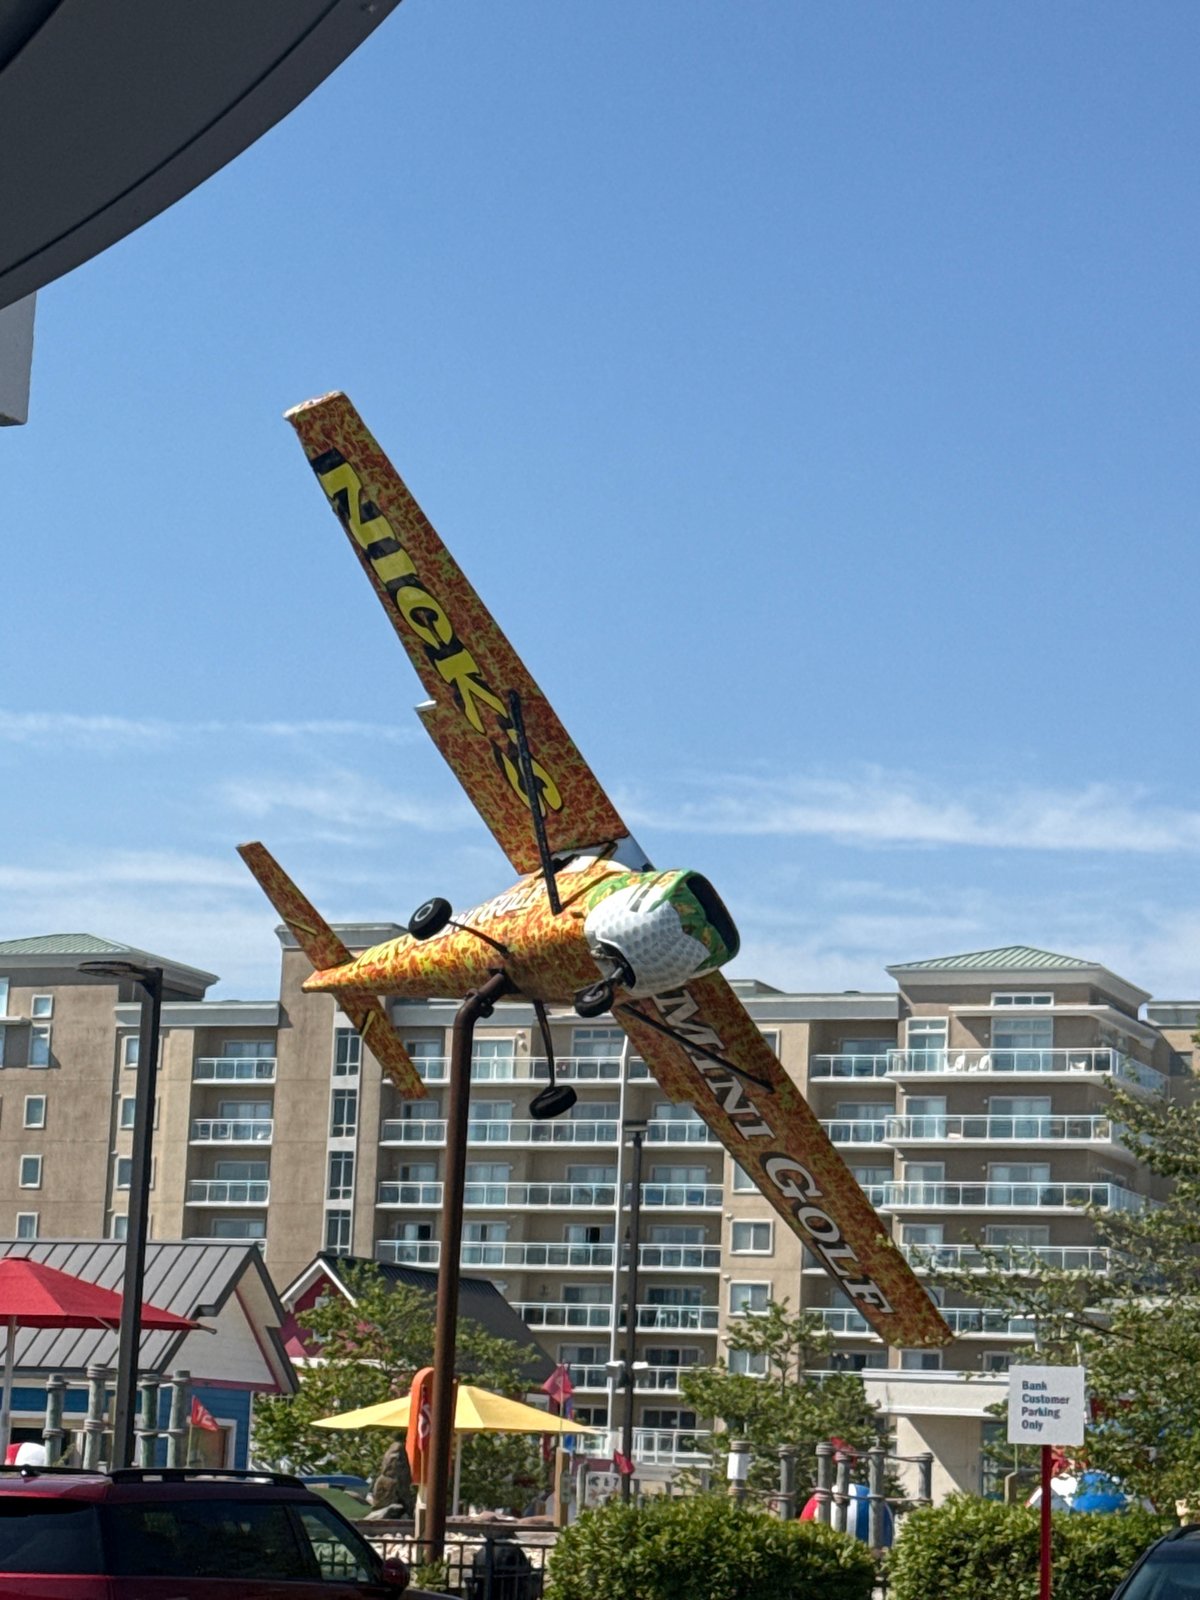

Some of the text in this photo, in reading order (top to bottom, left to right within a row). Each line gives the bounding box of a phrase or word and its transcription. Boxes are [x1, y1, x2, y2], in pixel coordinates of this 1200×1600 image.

[652, 989, 896, 1315] MINI GOLF
[1022, 1381, 1047, 1390] Bank
[1022, 1394, 1070, 1404] Customer
[1022, 1407, 1061, 1419] Parking
[1021, 1420, 1043, 1431] Only
